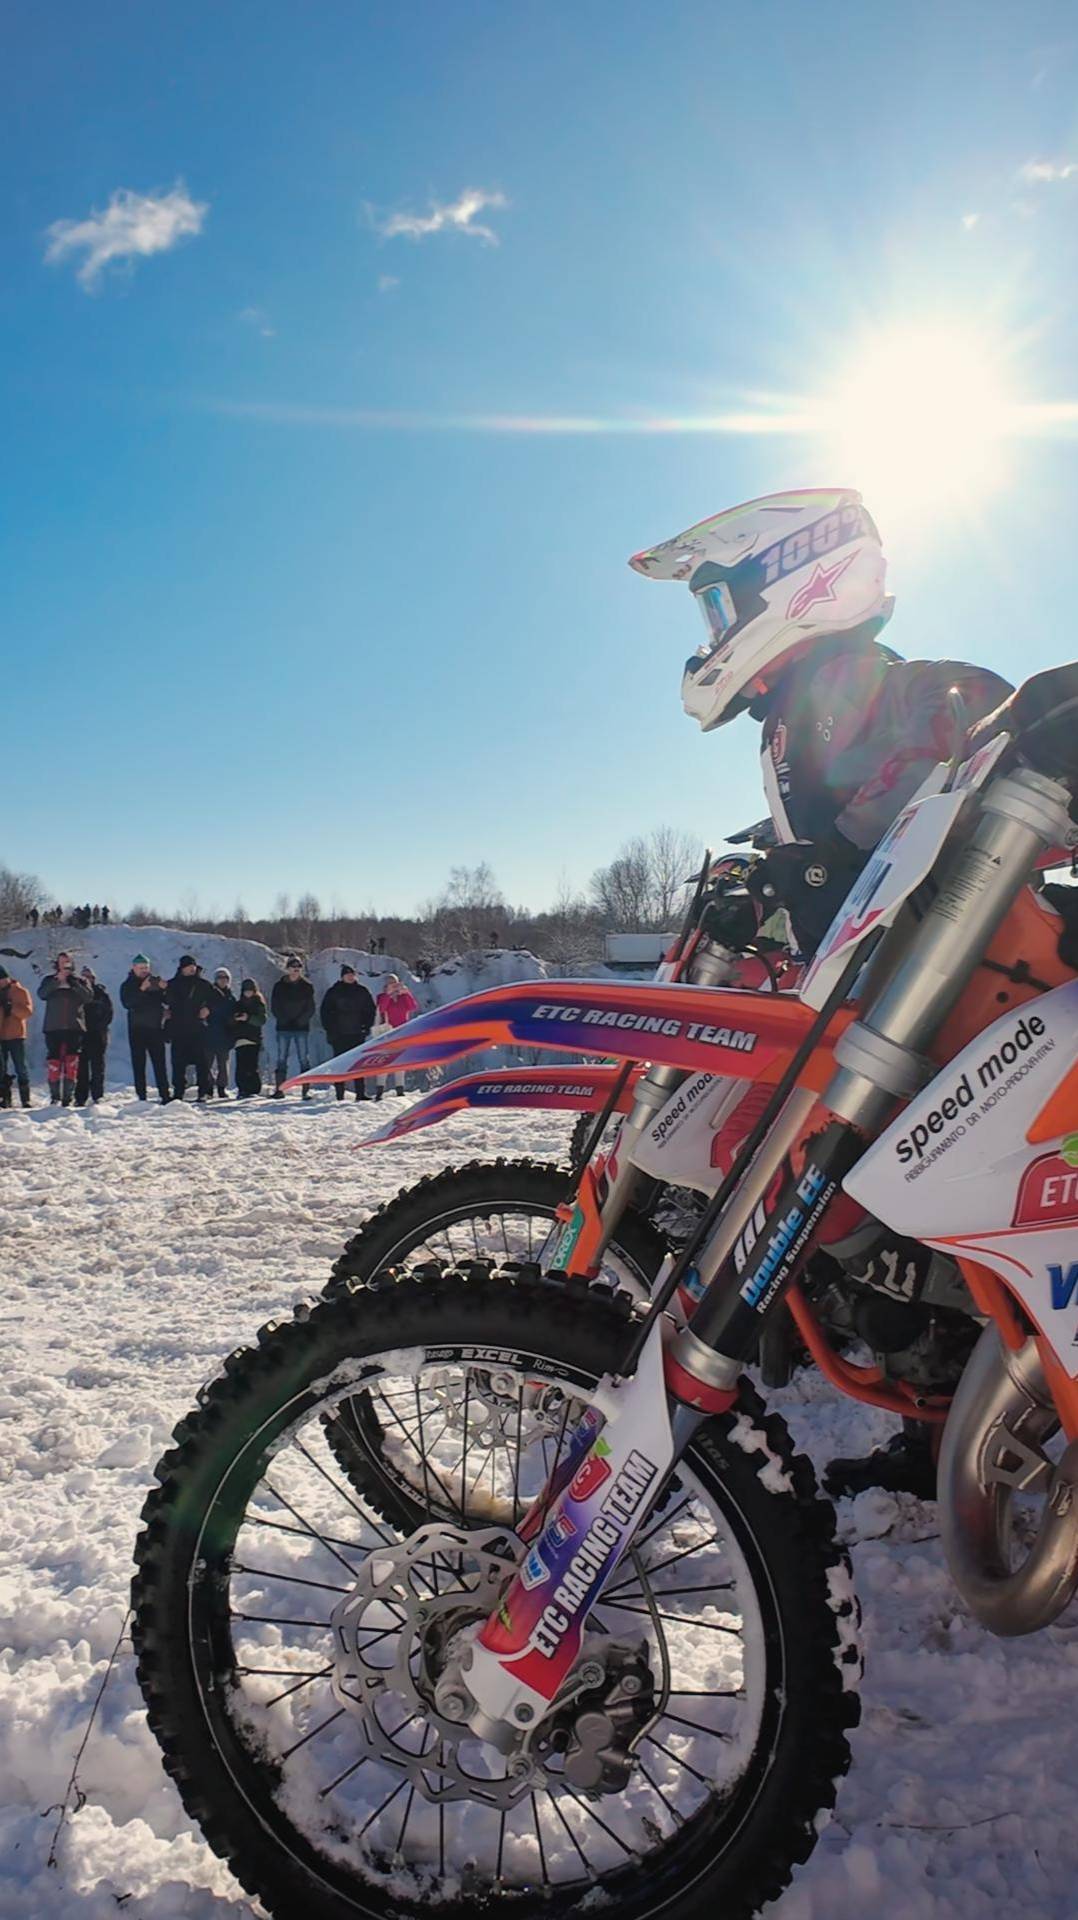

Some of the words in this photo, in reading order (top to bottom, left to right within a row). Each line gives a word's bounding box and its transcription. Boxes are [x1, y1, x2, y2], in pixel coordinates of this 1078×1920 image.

[532, 1005, 581, 1022] ETC
[582, 1009, 682, 1036] RACING
[686, 1023, 758, 1052] TEAM
[477, 1085, 502, 1095] ETC
[503, 1084, 556, 1095] RACING
[557, 1086, 594, 1097] TEAM
[896, 1074, 975, 1163] speed
[977, 1016, 1046, 1088] mode
[651, 1096, 687, 1142] speed
[1040, 1173, 1078, 1208] ET
[739, 1206, 804, 1307] Double
[796, 1163, 826, 1207] EE
[756, 1267, 790, 1314] Racing
[785, 1181, 836, 1265] Suspension
[461, 1348, 523, 1365] EXCEL
[531, 1604, 571, 1659] ETC
[554, 1516, 623, 1616] RACING
[600, 1449, 659, 1526] TEAM
